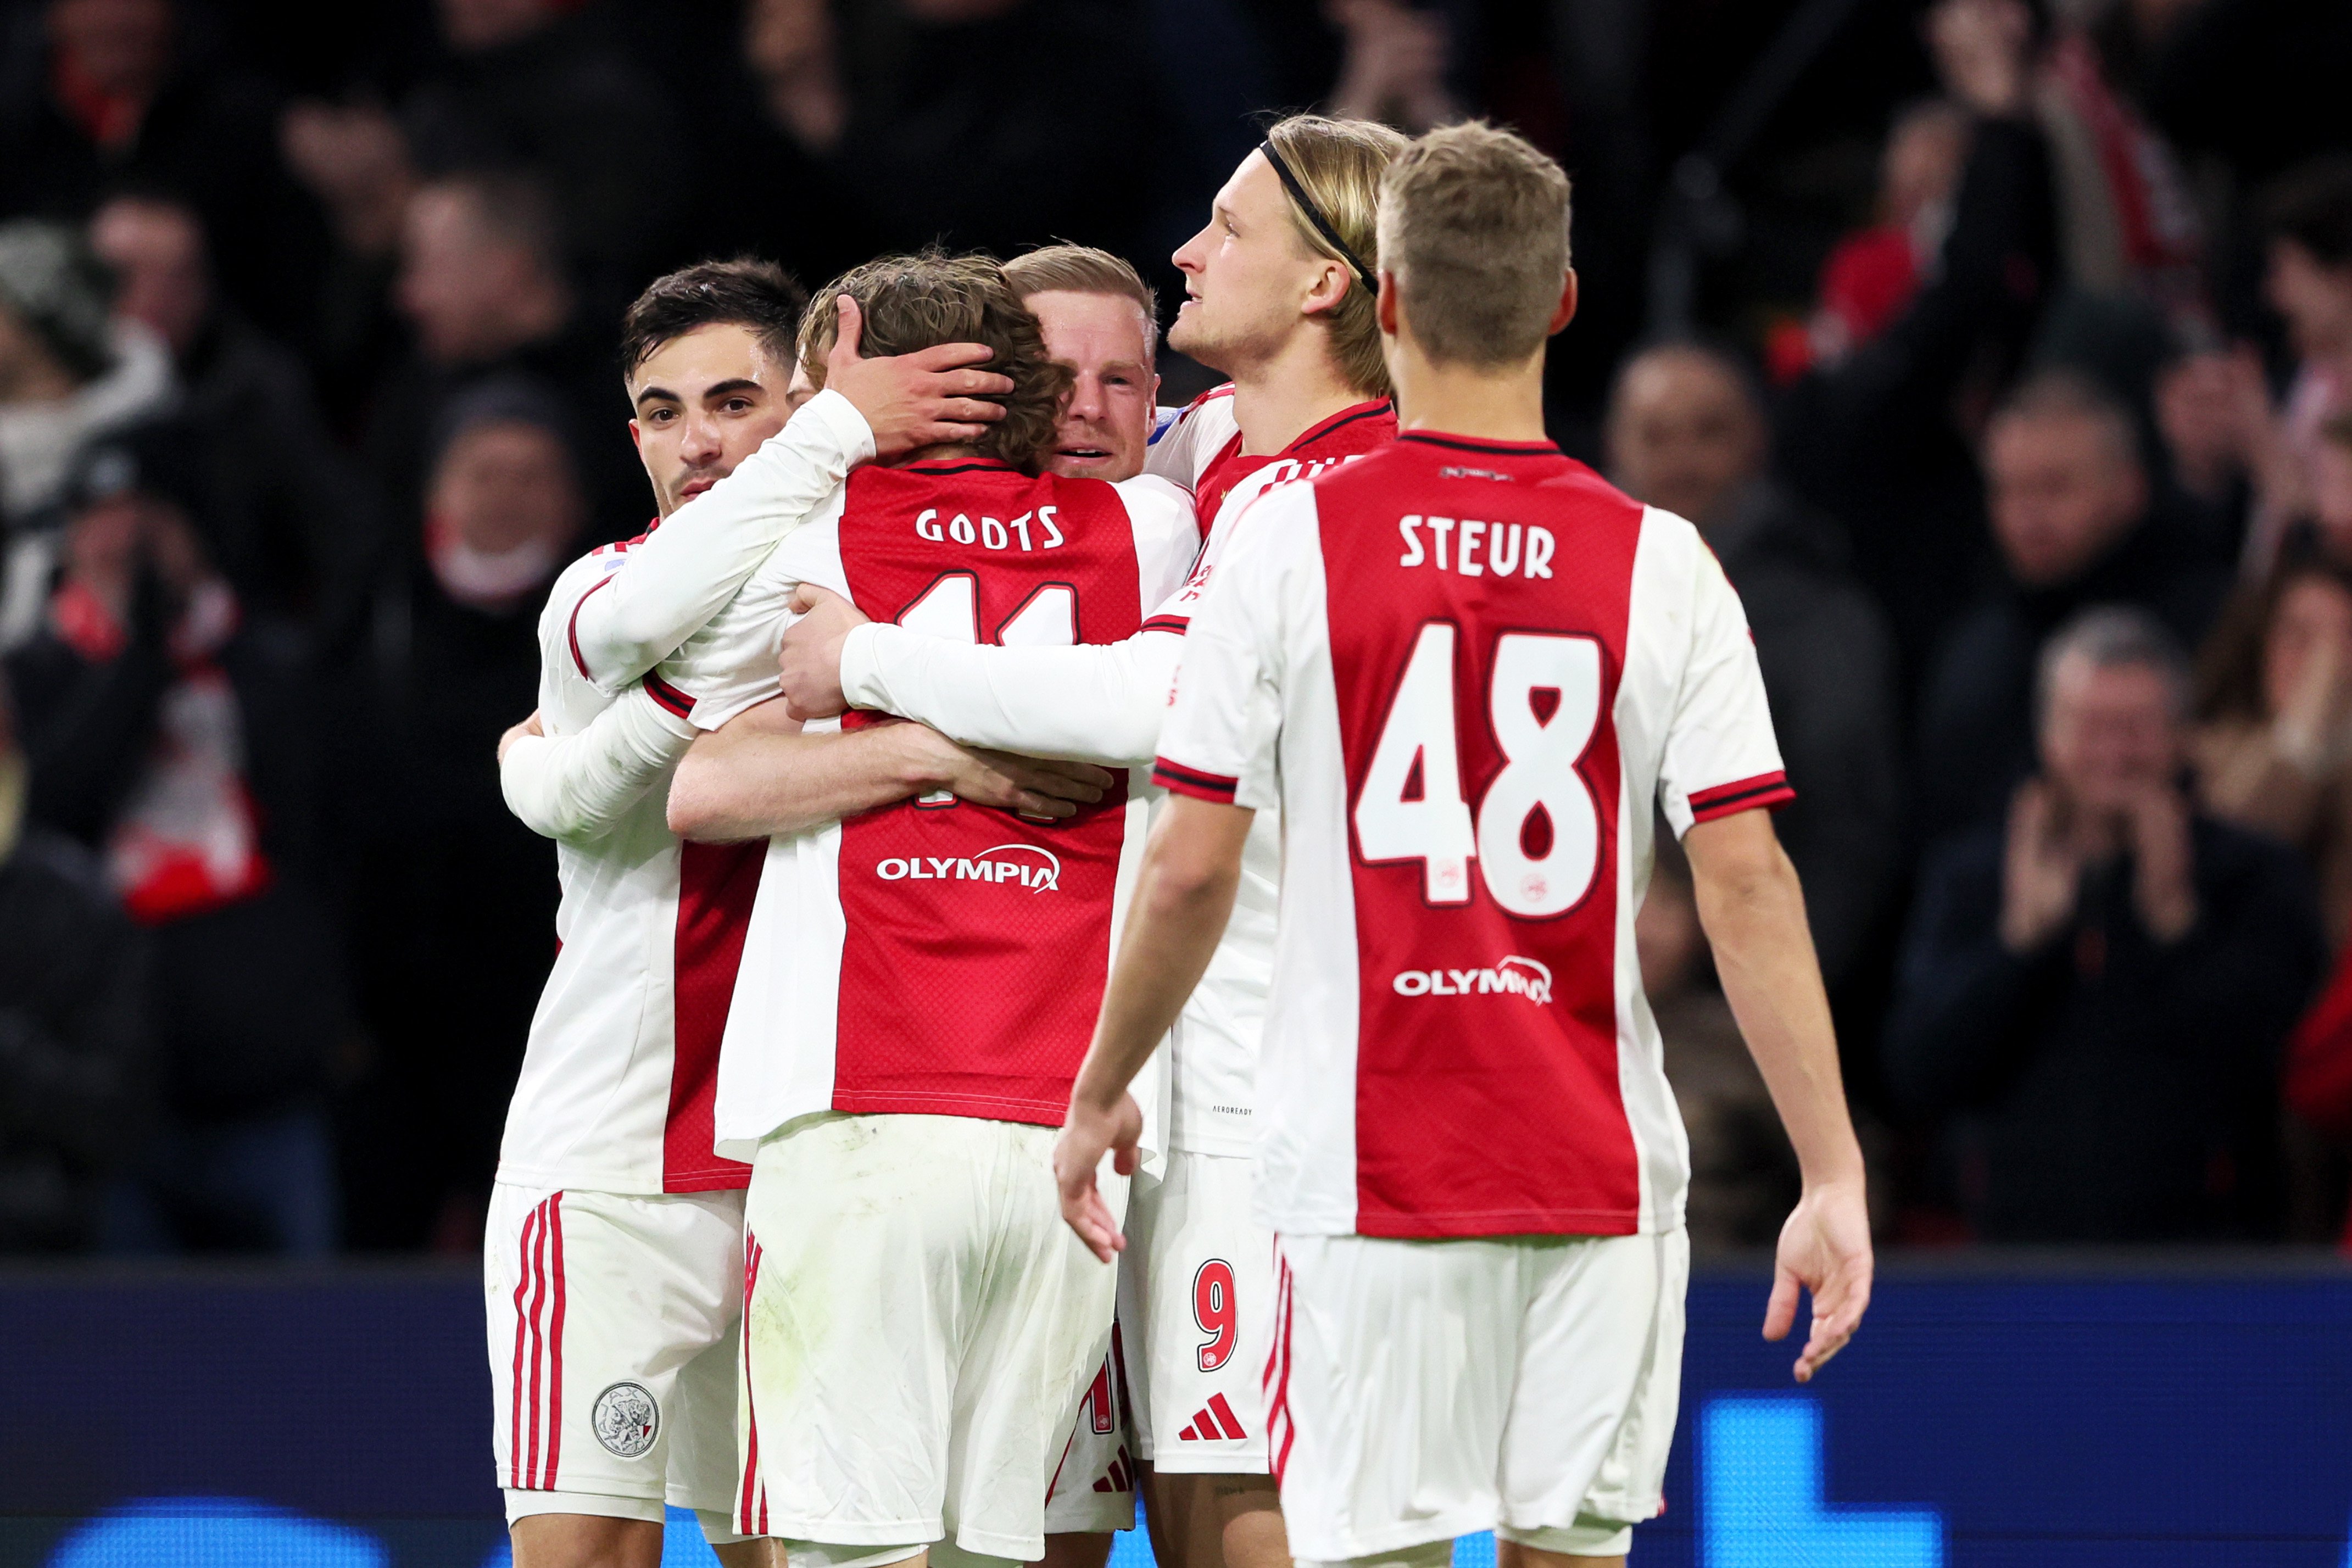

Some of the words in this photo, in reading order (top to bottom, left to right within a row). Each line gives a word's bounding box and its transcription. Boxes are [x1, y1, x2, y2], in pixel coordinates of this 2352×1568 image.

[915, 505, 1064, 551] GODTS
[1398, 514, 1556, 579] STEUR
[1352, 617, 1606, 923] 48
[876, 855, 1061, 894] OLYMPIA
[1212, 1105, 1253, 1116] AEROREADY
[1192, 1258, 1239, 1372] 9
